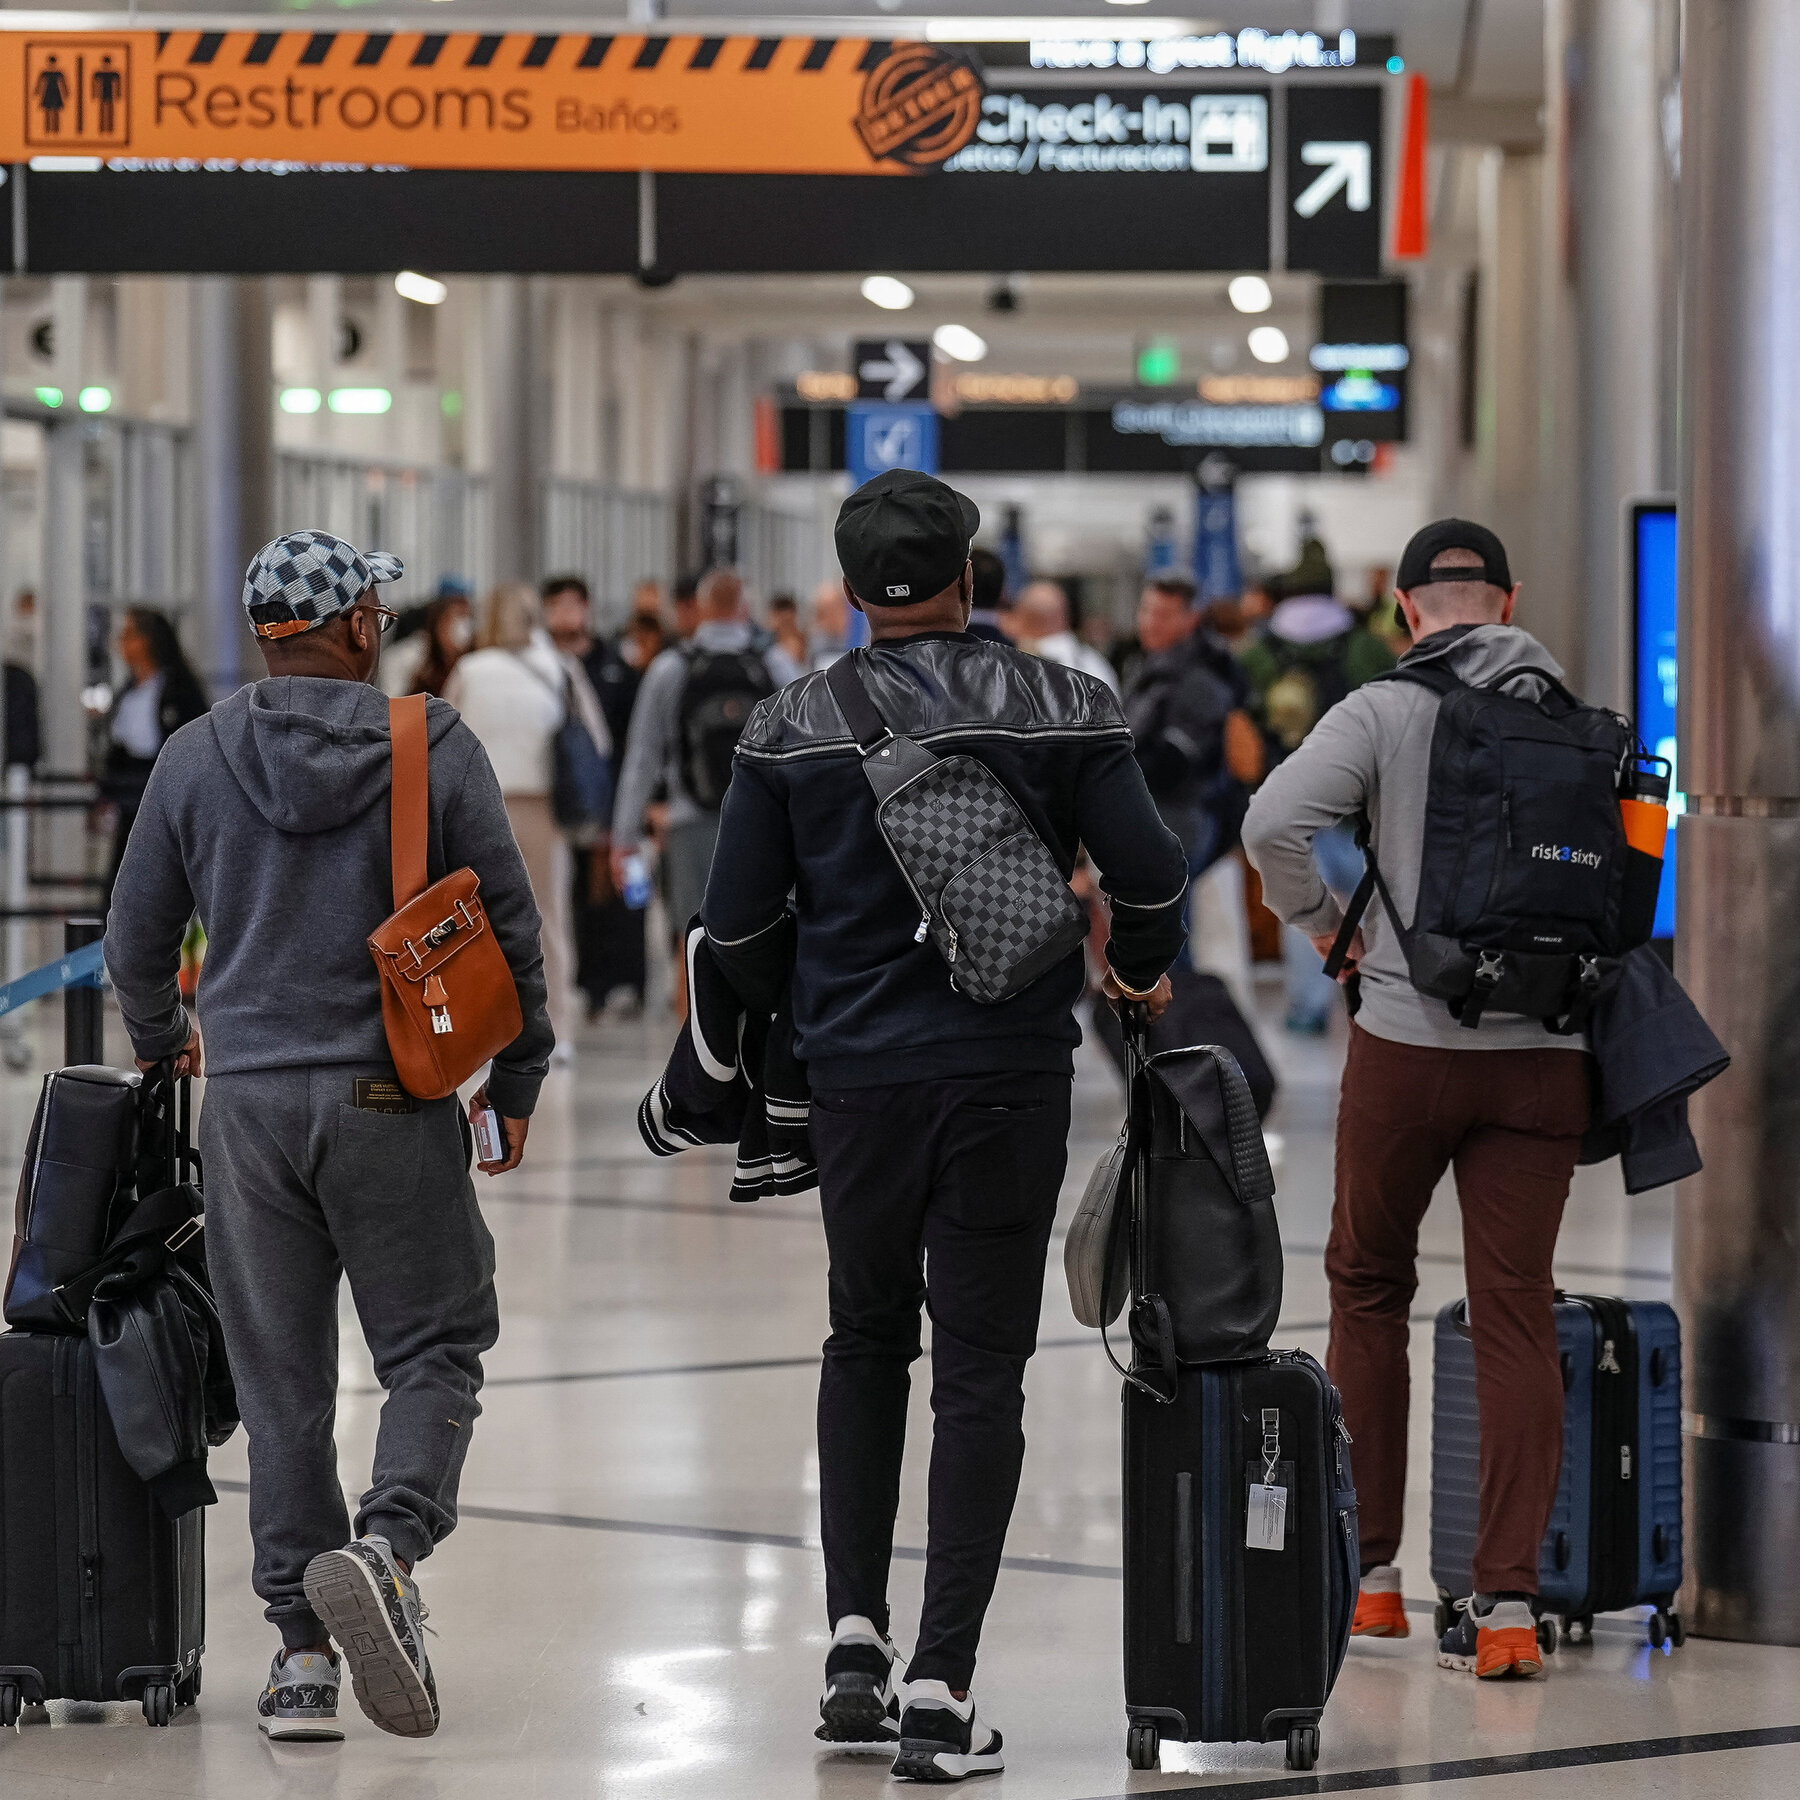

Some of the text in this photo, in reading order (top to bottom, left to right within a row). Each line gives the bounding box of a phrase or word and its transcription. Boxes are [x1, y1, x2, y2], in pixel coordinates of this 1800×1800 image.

[153, 71, 682, 134] Restrooms Baños
[1531, 844, 1602, 869] risk3sixty
